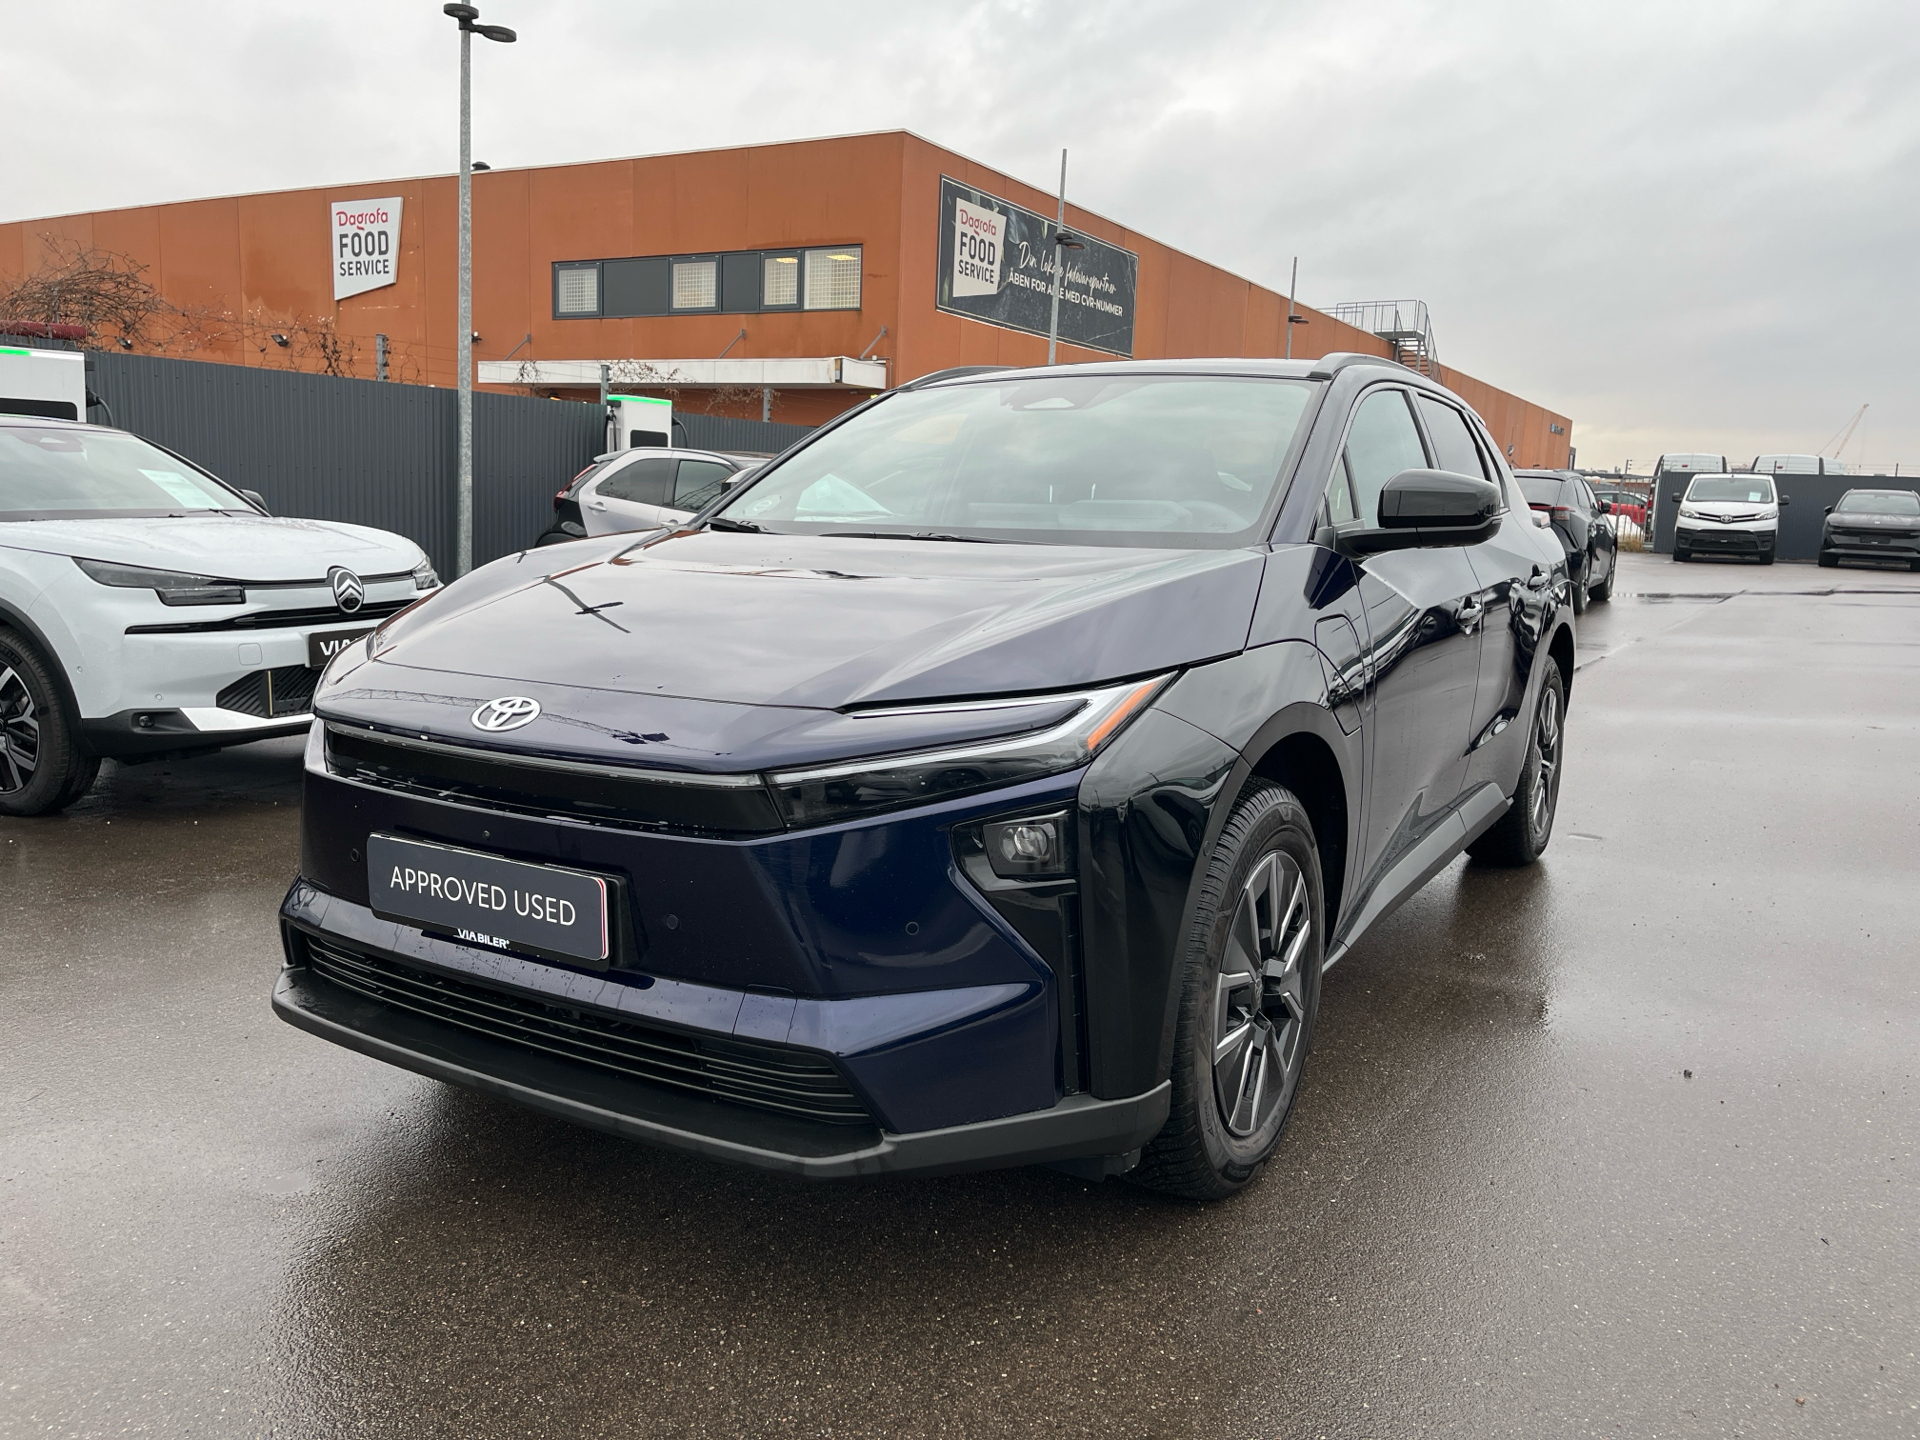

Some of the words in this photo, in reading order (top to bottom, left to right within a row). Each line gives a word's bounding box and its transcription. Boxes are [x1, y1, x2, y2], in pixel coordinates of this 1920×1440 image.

[336, 207, 388, 230] Dagrofa
[959, 208, 997, 237] Dagrofa
[339, 230, 389, 258] FOOD
[959, 231, 995, 266] FOOD
[340, 259, 390, 276] SERVICE
[958, 259, 995, 284] SERVICE
[1019, 241, 1037, 269] Din
[1041, 249, 1064, 277] lokae
[1008, 267, 1030, 289] ÅBEN
[1031, 279, 1046, 294] FOR
[1047, 285, 1064, 299] AE
[1065, 289, 1080, 303] MED
[1081, 294, 1123, 317] CVR-NUMMER
[390, 865, 507, 912] APPROVED
[514, 889, 576, 927] USED
